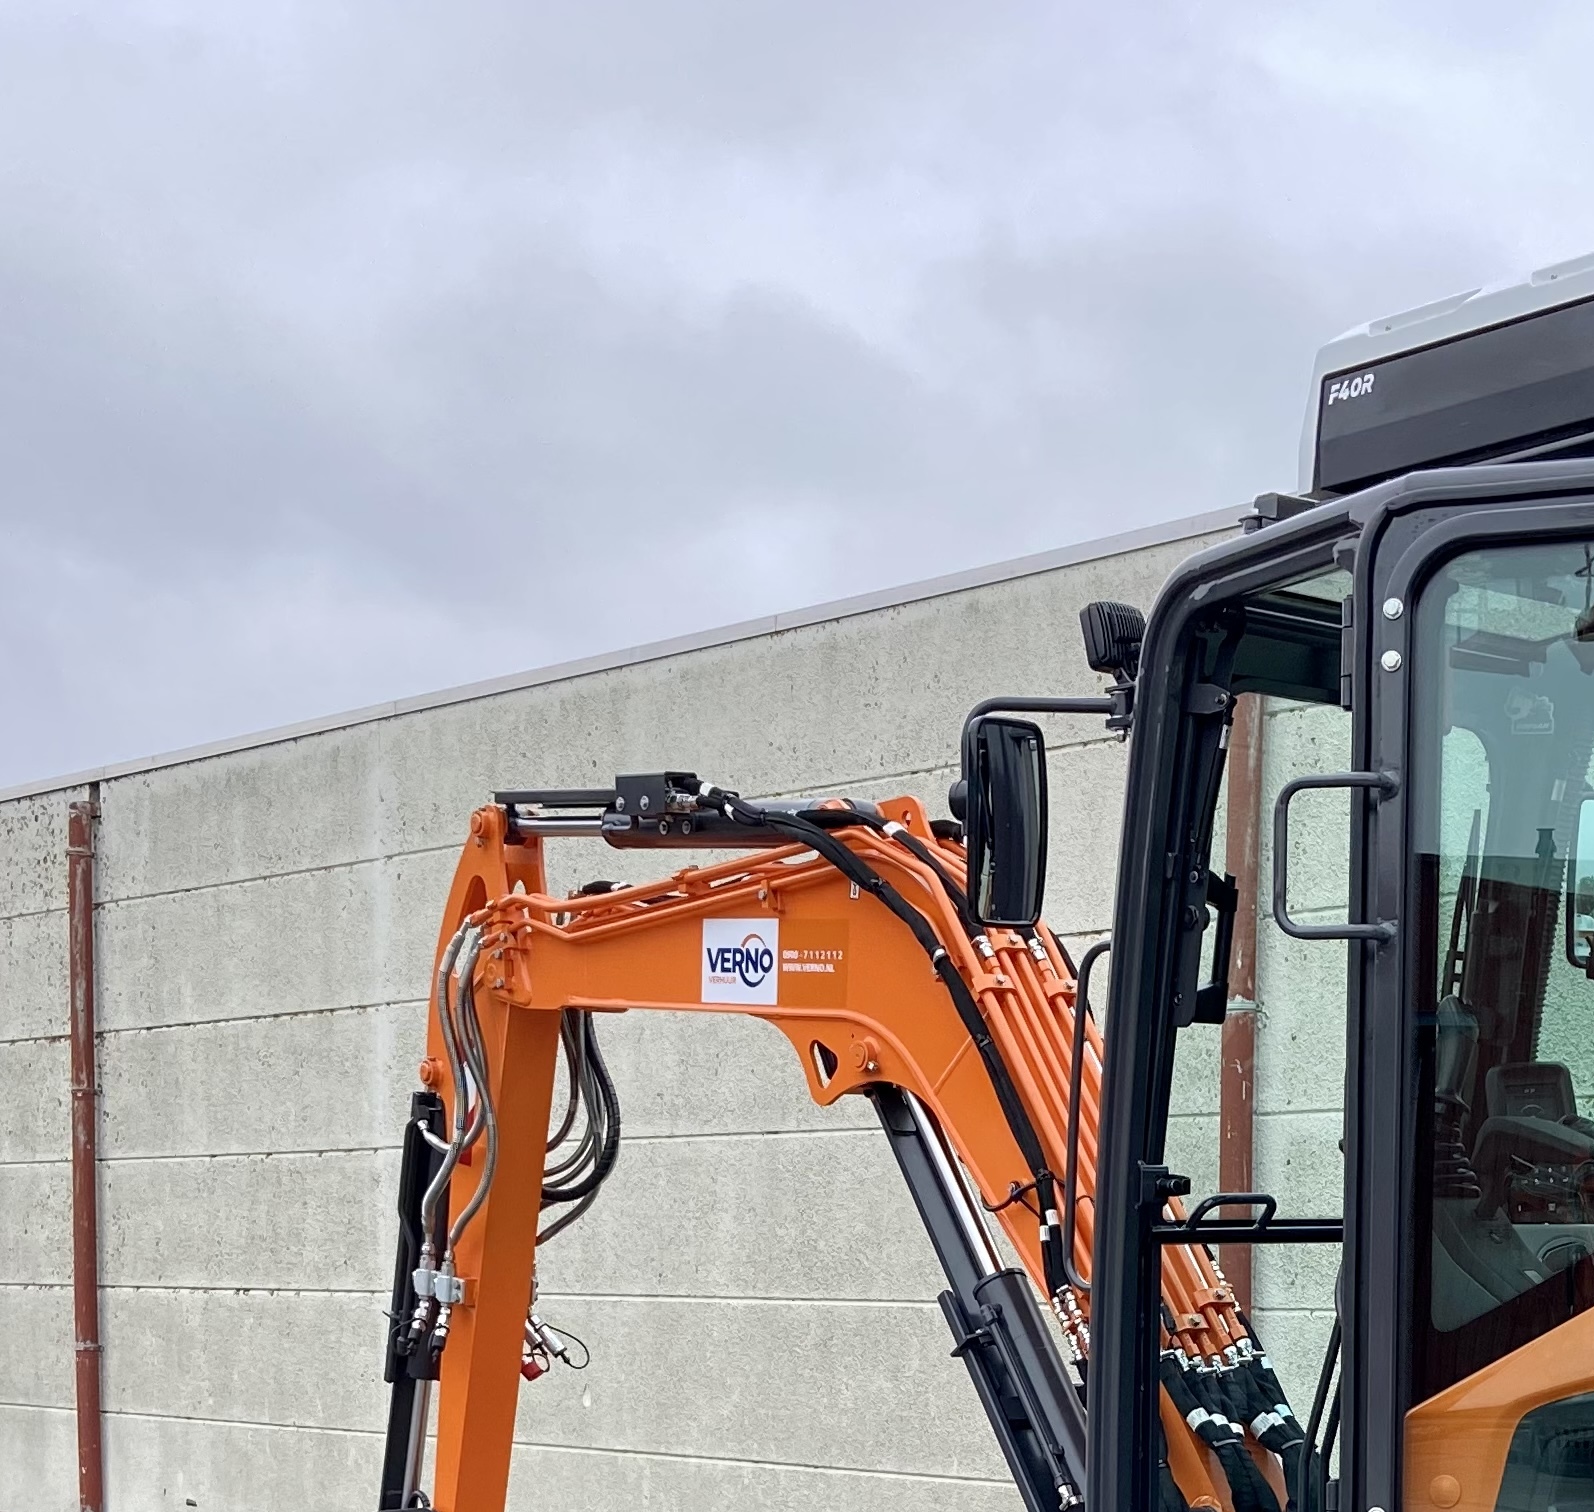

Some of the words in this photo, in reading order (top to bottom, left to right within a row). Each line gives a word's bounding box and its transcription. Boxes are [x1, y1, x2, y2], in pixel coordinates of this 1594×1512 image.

[1328, 373, 1375, 406] F40R
[707, 948, 774, 987] VERNO
[708, 975, 737, 984] VERHUUR
